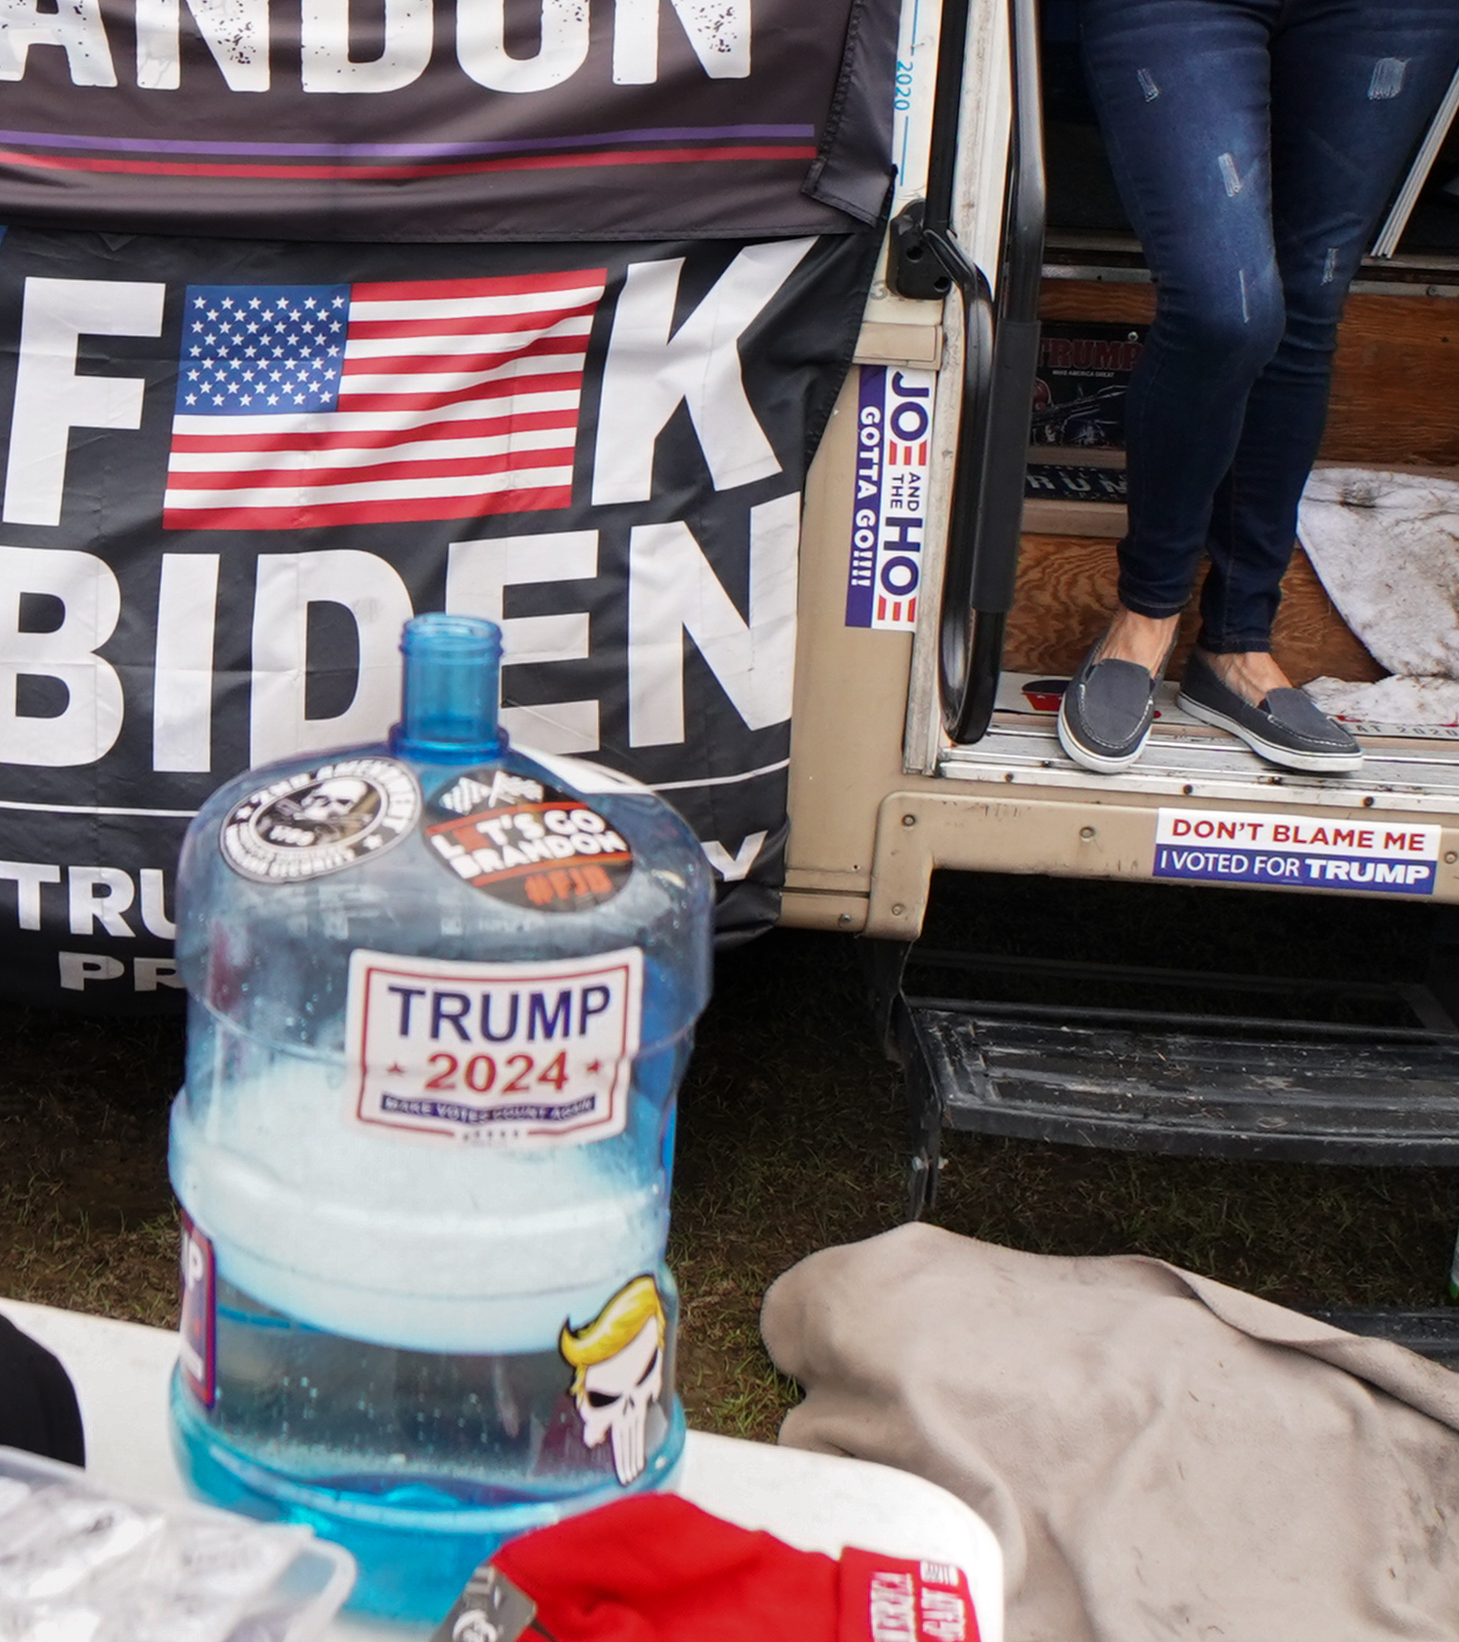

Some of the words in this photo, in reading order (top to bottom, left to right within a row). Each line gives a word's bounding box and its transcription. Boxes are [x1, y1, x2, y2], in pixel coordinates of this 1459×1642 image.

[888, 369, 931, 466] JOE
[857, 404, 881, 500] GOTTA
[891, 474, 904, 509] THE
[907, 472, 920, 512] AND
[878, 514, 923, 622] HOE
[1172, 818, 1264, 840] DON'T
[1272, 824, 1374, 848] BLAME
[1383, 832, 1426, 852] ME
[1160, 850, 1167, 868] I
[1172, 852, 1249, 874] VOTED
[1254, 856, 1300, 877] FOR
[1305, 859, 1430, 884] TRUMP
[387, 985, 611, 1043] TRUMP
[425, 1051, 569, 1093] 2024
